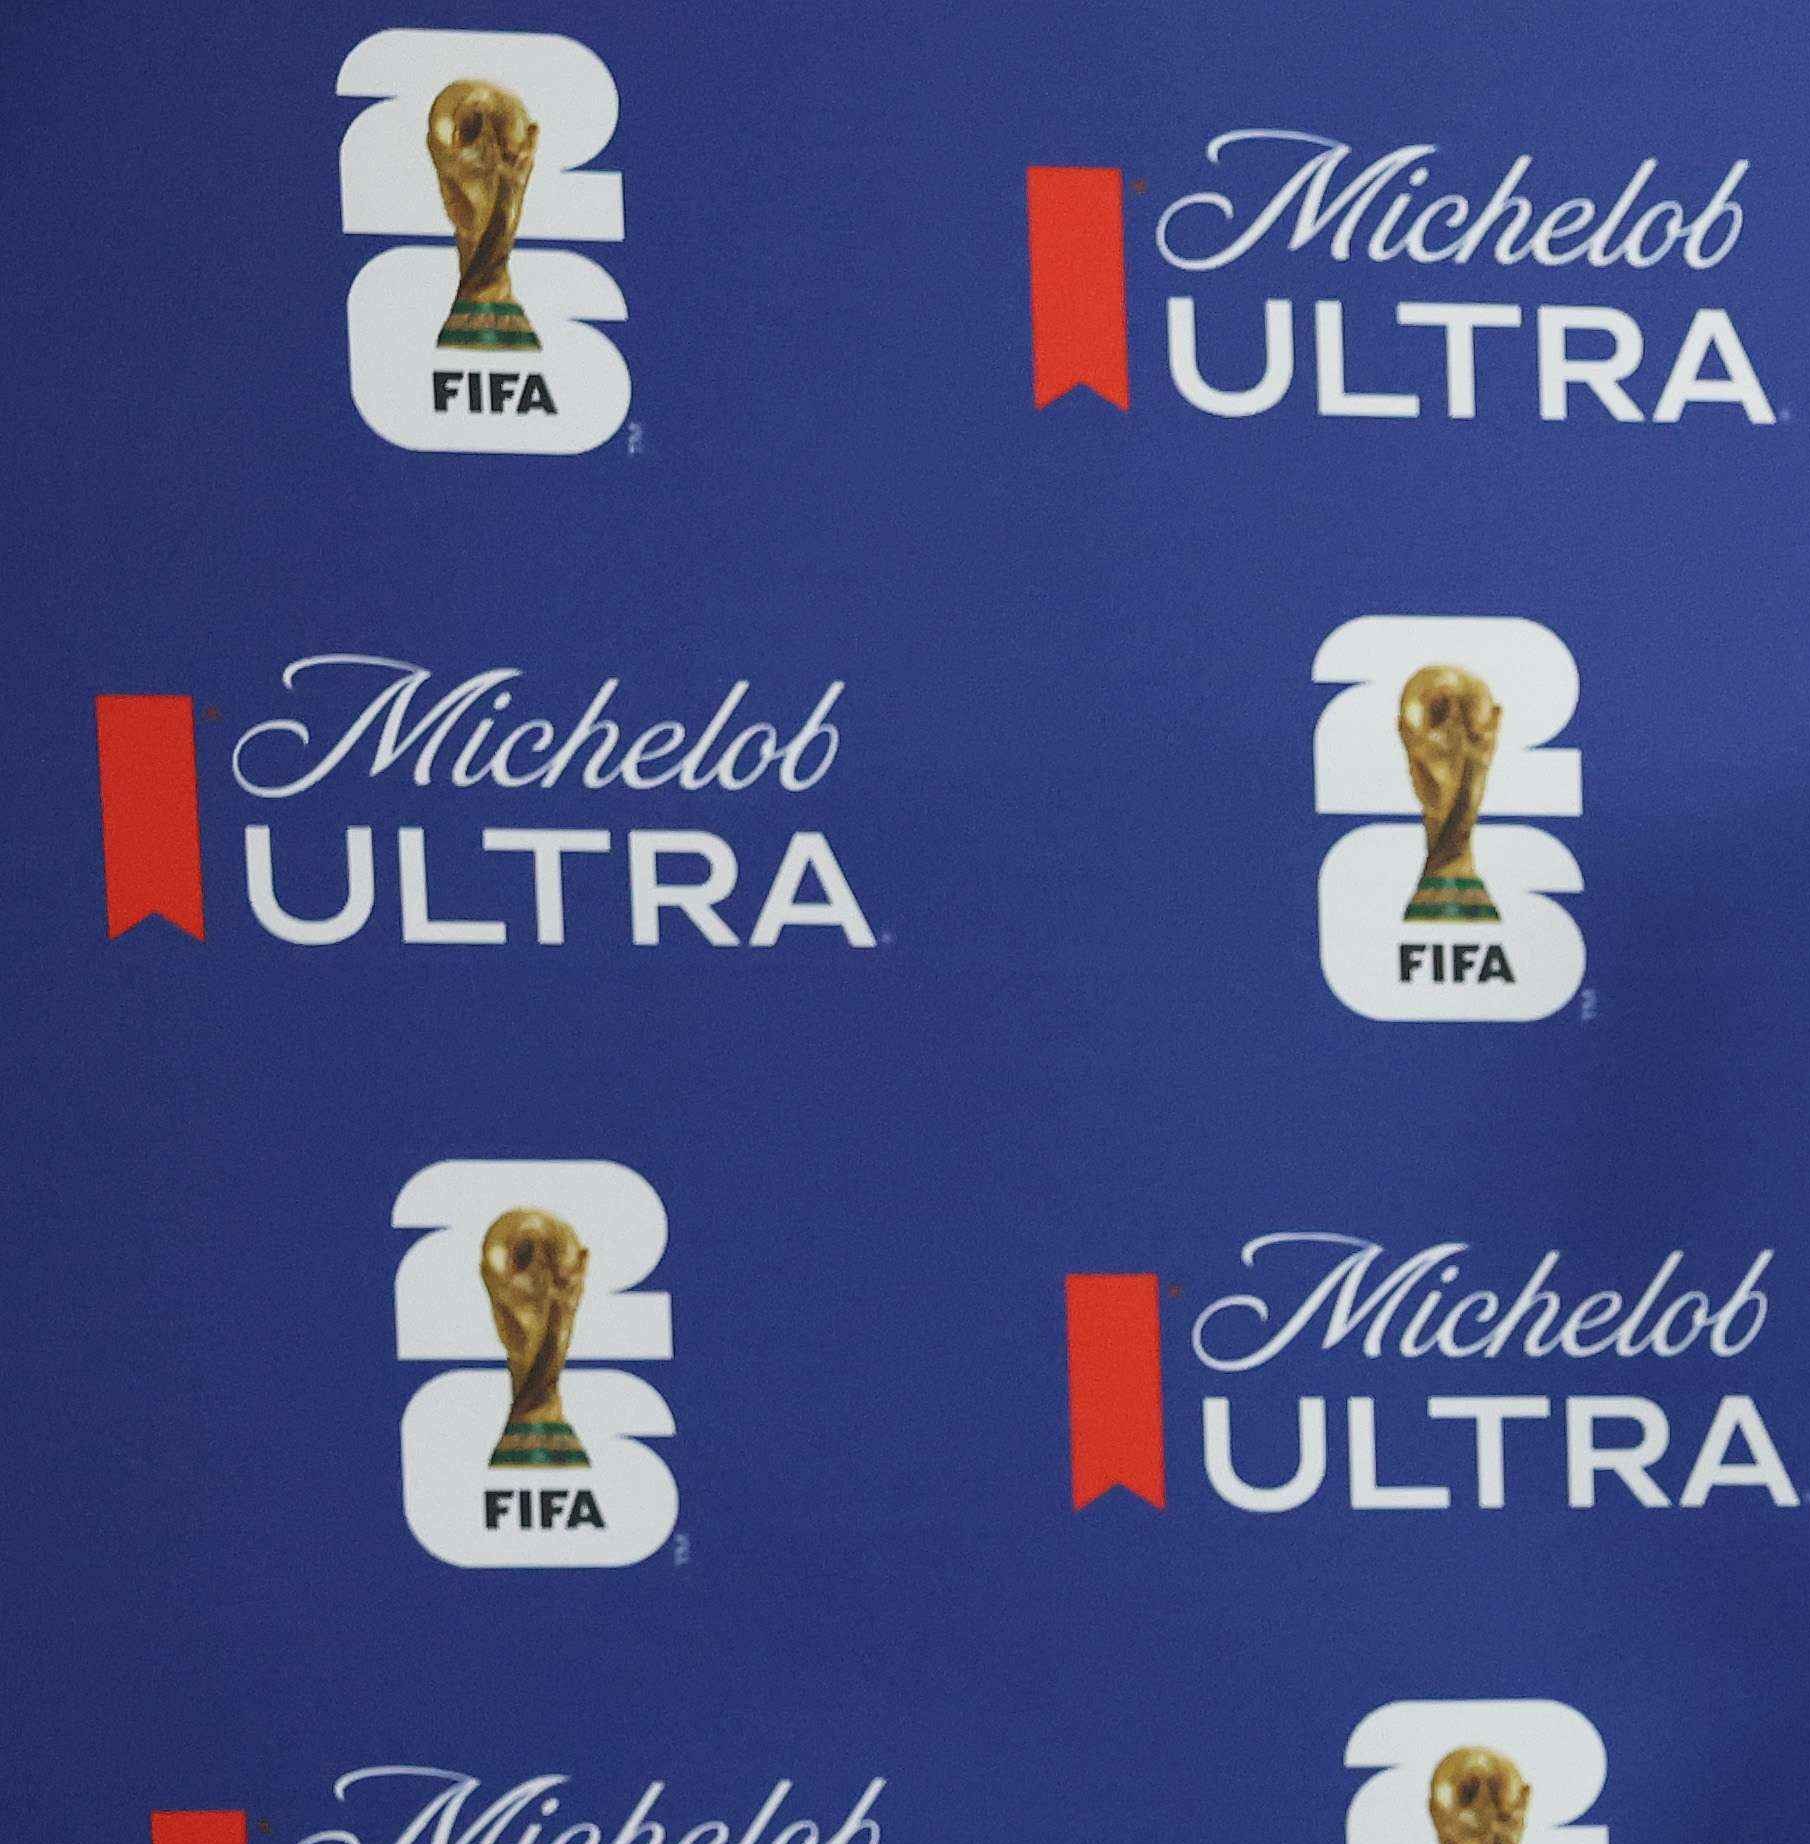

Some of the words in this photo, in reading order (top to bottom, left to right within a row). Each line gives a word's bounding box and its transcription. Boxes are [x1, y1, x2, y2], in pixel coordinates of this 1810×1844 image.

[1155, 128, 1750, 272] Michelob
[432, 370, 558, 415] FIFA
[1166, 296, 1777, 426] ULTRA
[231, 653, 846, 799] Michelob
[243, 824, 878, 949] ULTRA
[1398, 943, 1516, 984] FIFA
[1191, 1231, 1774, 1372] Michelob
[484, 1489, 606, 1530] FIFA
[1202, 1394, 1801, 1514] ULTRA
